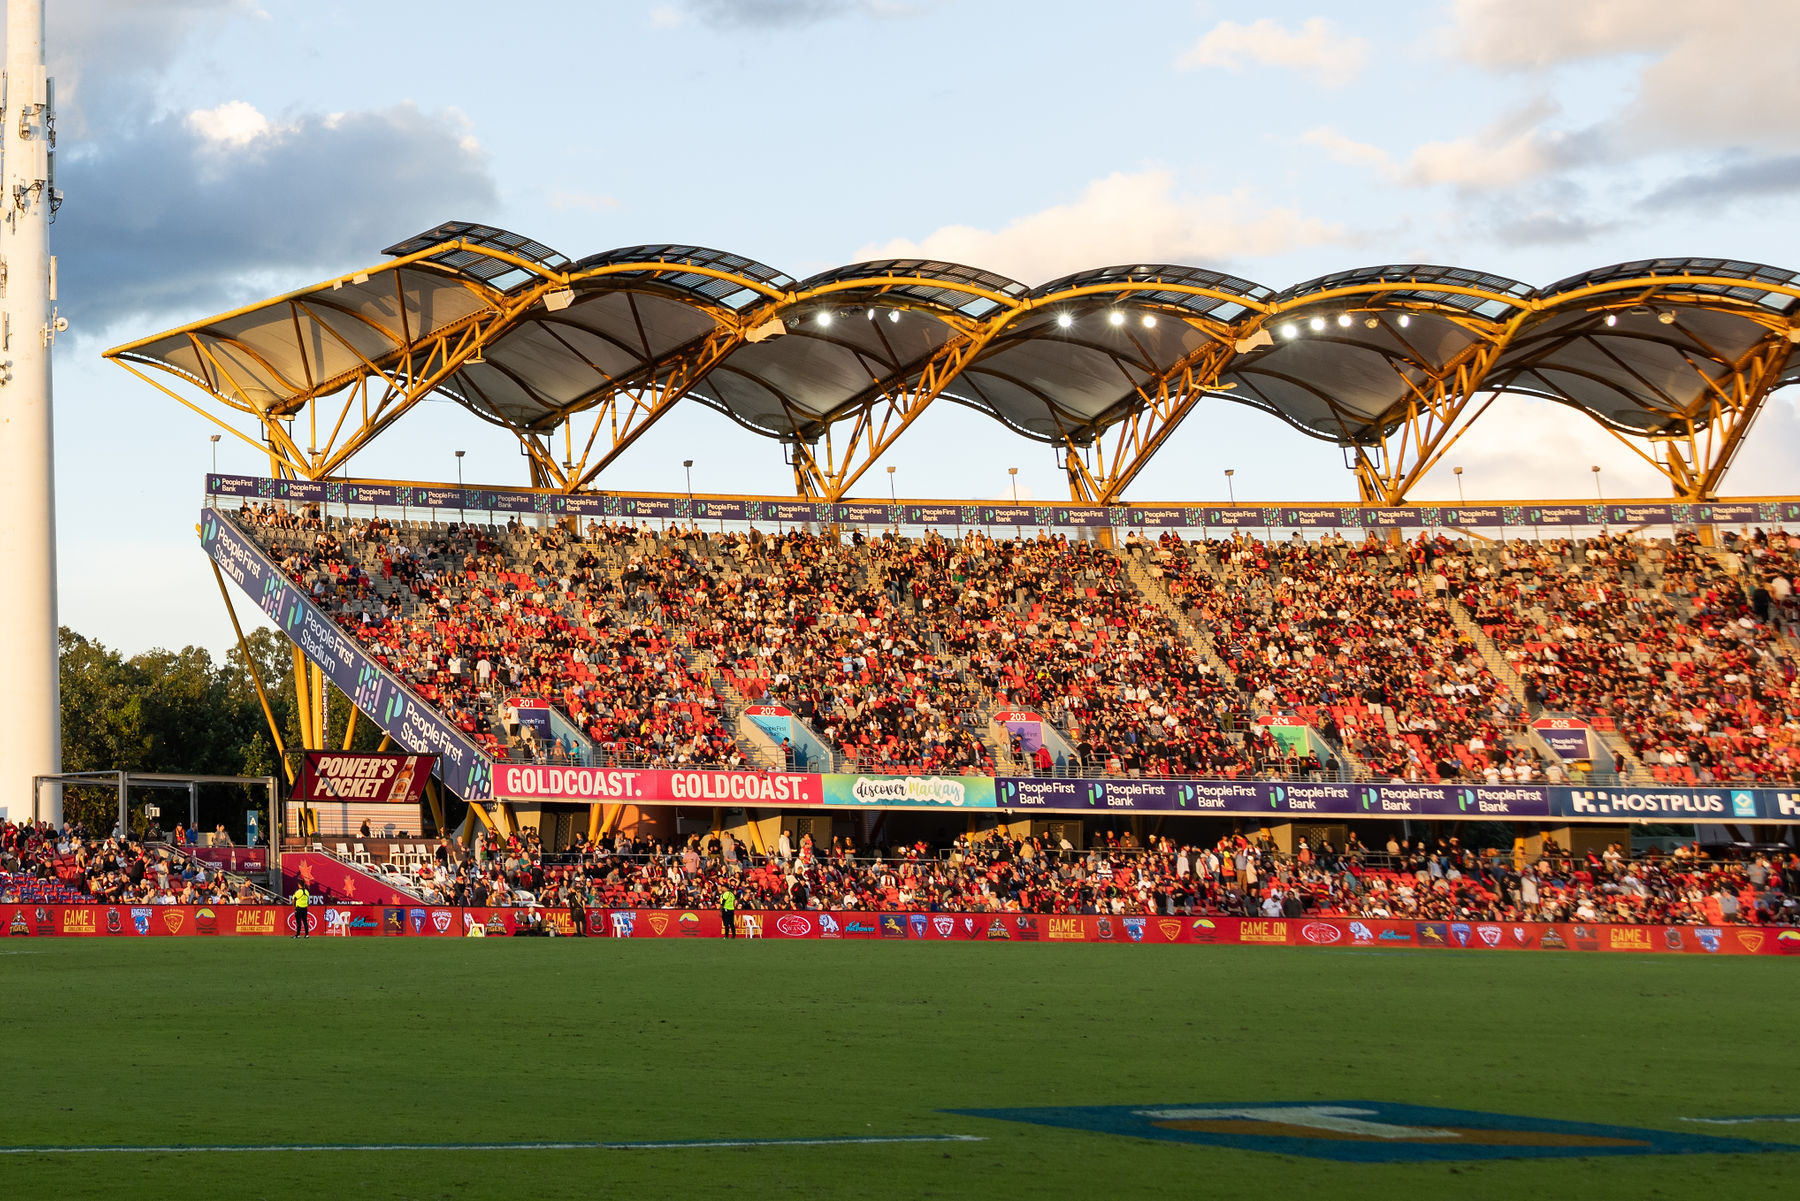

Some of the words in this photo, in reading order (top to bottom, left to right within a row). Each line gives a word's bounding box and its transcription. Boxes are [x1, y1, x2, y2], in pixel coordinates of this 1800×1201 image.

[222, 478, 240, 486] People
[429, 492, 447, 500] People
[637, 501, 655, 509] People
[218, 526, 243, 562] People
[243, 552, 261, 579] First
[214, 543, 245, 585] Stadium
[305, 609, 333, 648] People
[334, 637, 354, 668] First
[301, 629, 336, 674] Stadium
[520, 699, 534, 707] 201
[761, 707, 776, 715] 202
[1010, 713, 1026, 721] 203
[1551, 720, 1569, 728] 205
[405, 701, 440, 742] People
[439, 730, 463, 766] First
[315, 757, 397, 778] POWER'S
[314, 778, 384, 798] POCKET
[857, 782, 906, 797] discover
[1018, 782, 1051, 794] People
[1053, 783, 1075, 793] First
[1106, 783, 1142, 795] People
[1143, 784, 1165, 795] First
[1197, 785, 1233, 797] People
[1234, 786, 1256, 796] First
[1287, 787, 1324, 800] People
[1325, 787, 1348, 798] First
[1380, 788, 1418, 800] People
[1420, 789, 1444, 800] First
[1019, 794, 1044, 804] Bank
[1107, 795, 1134, 806] Bank
[1477, 789, 1515, 801] People
[1517, 790, 1542, 801] First
[1198, 797, 1225, 808] Bank
[1289, 798, 1316, 809] Bank
[1382, 800, 1411, 811] Bank
[1478, 801, 1508, 812] Bank
[1611, 793, 1723, 812] HOSTPLUS
[250, 817, 256, 825] A
[236, 911, 261, 925] GAME
[264, 911, 275, 925] ON
[1241, 922, 1267, 935] GAME
[1274, 922, 1286, 936] ON
